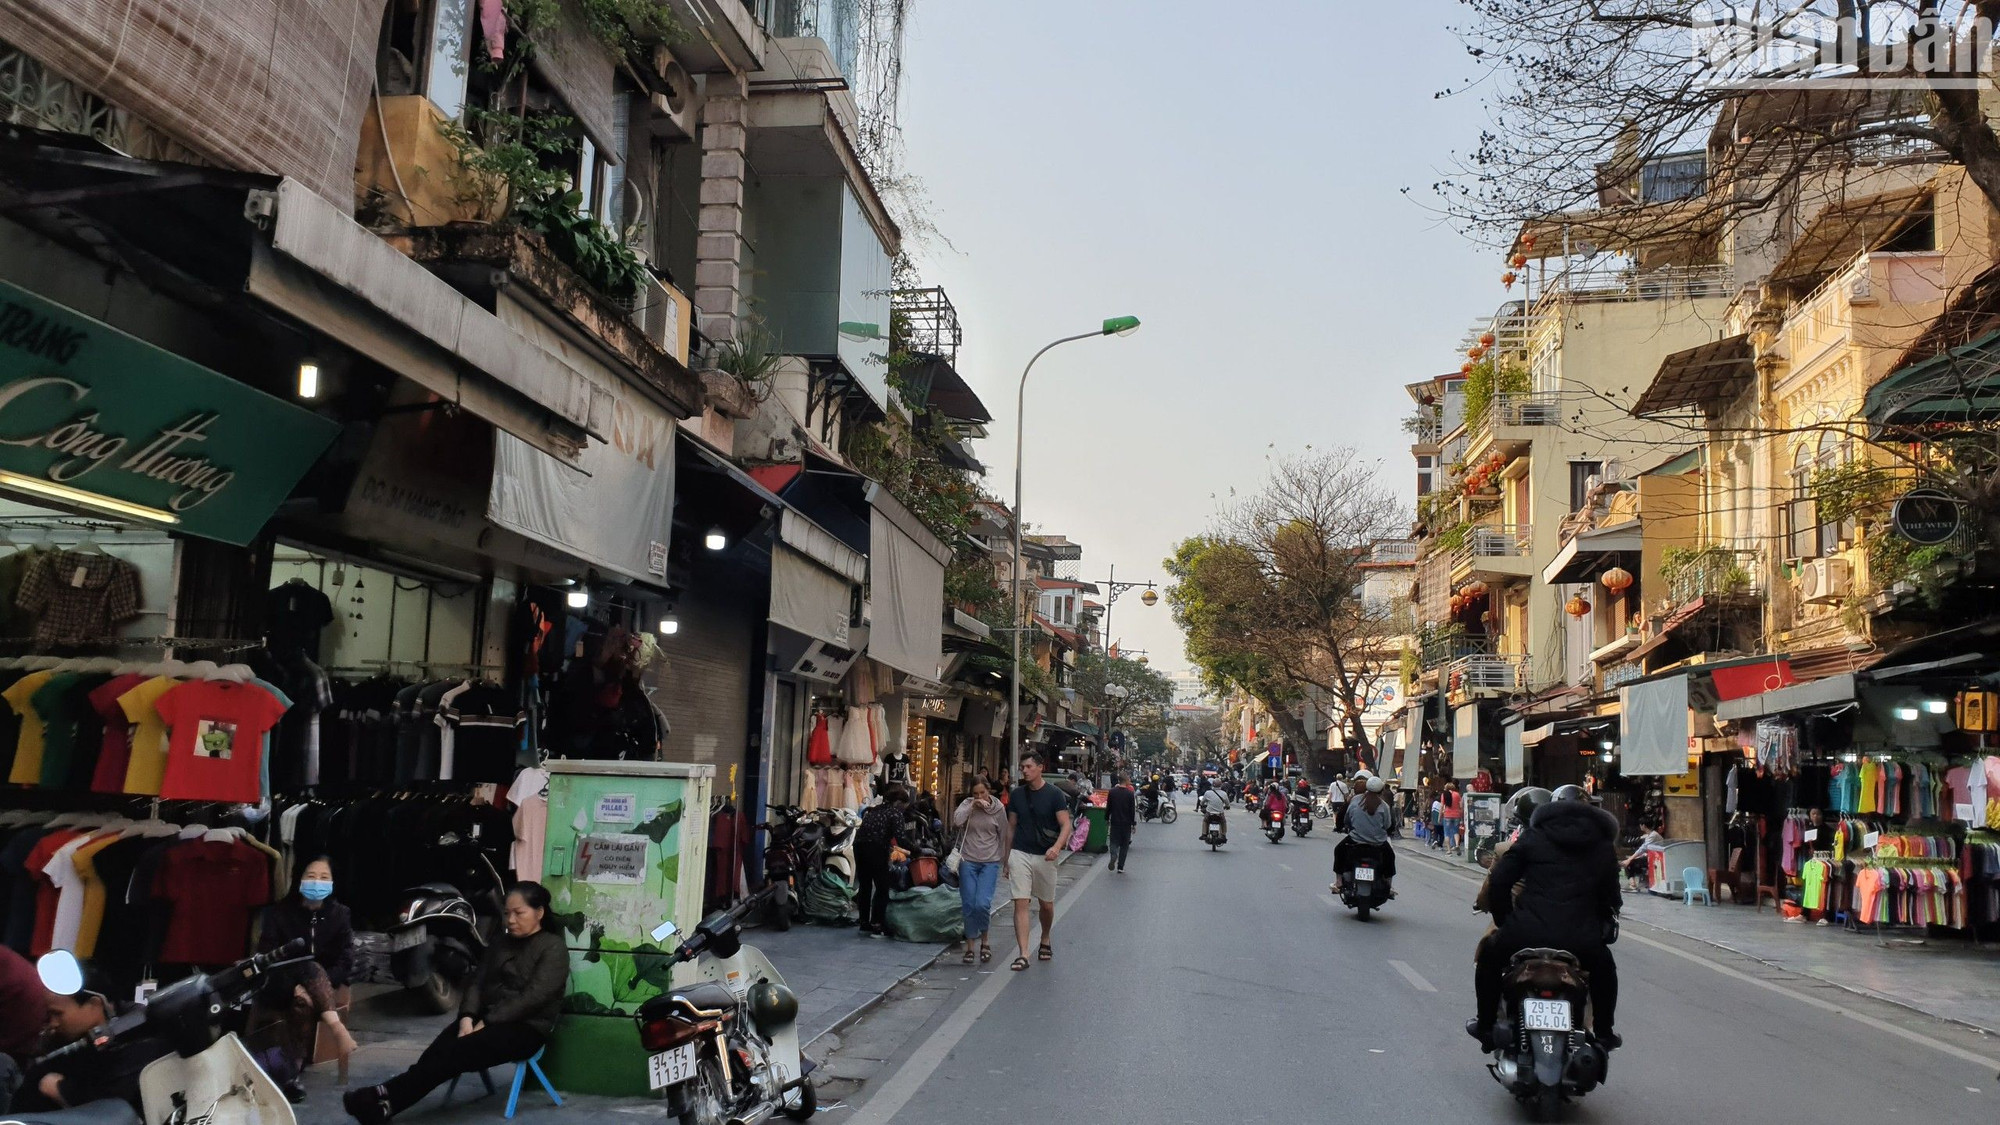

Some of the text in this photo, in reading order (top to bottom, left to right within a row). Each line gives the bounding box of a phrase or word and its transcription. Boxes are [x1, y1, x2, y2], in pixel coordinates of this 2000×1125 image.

[1531, 1001, 1563, 1015] 29-E2
[1528, 1014, 1567, 1029] 054.04
[653, 1046, 688, 1071] 34-F4
[655, 1061, 688, 1086] 1137
